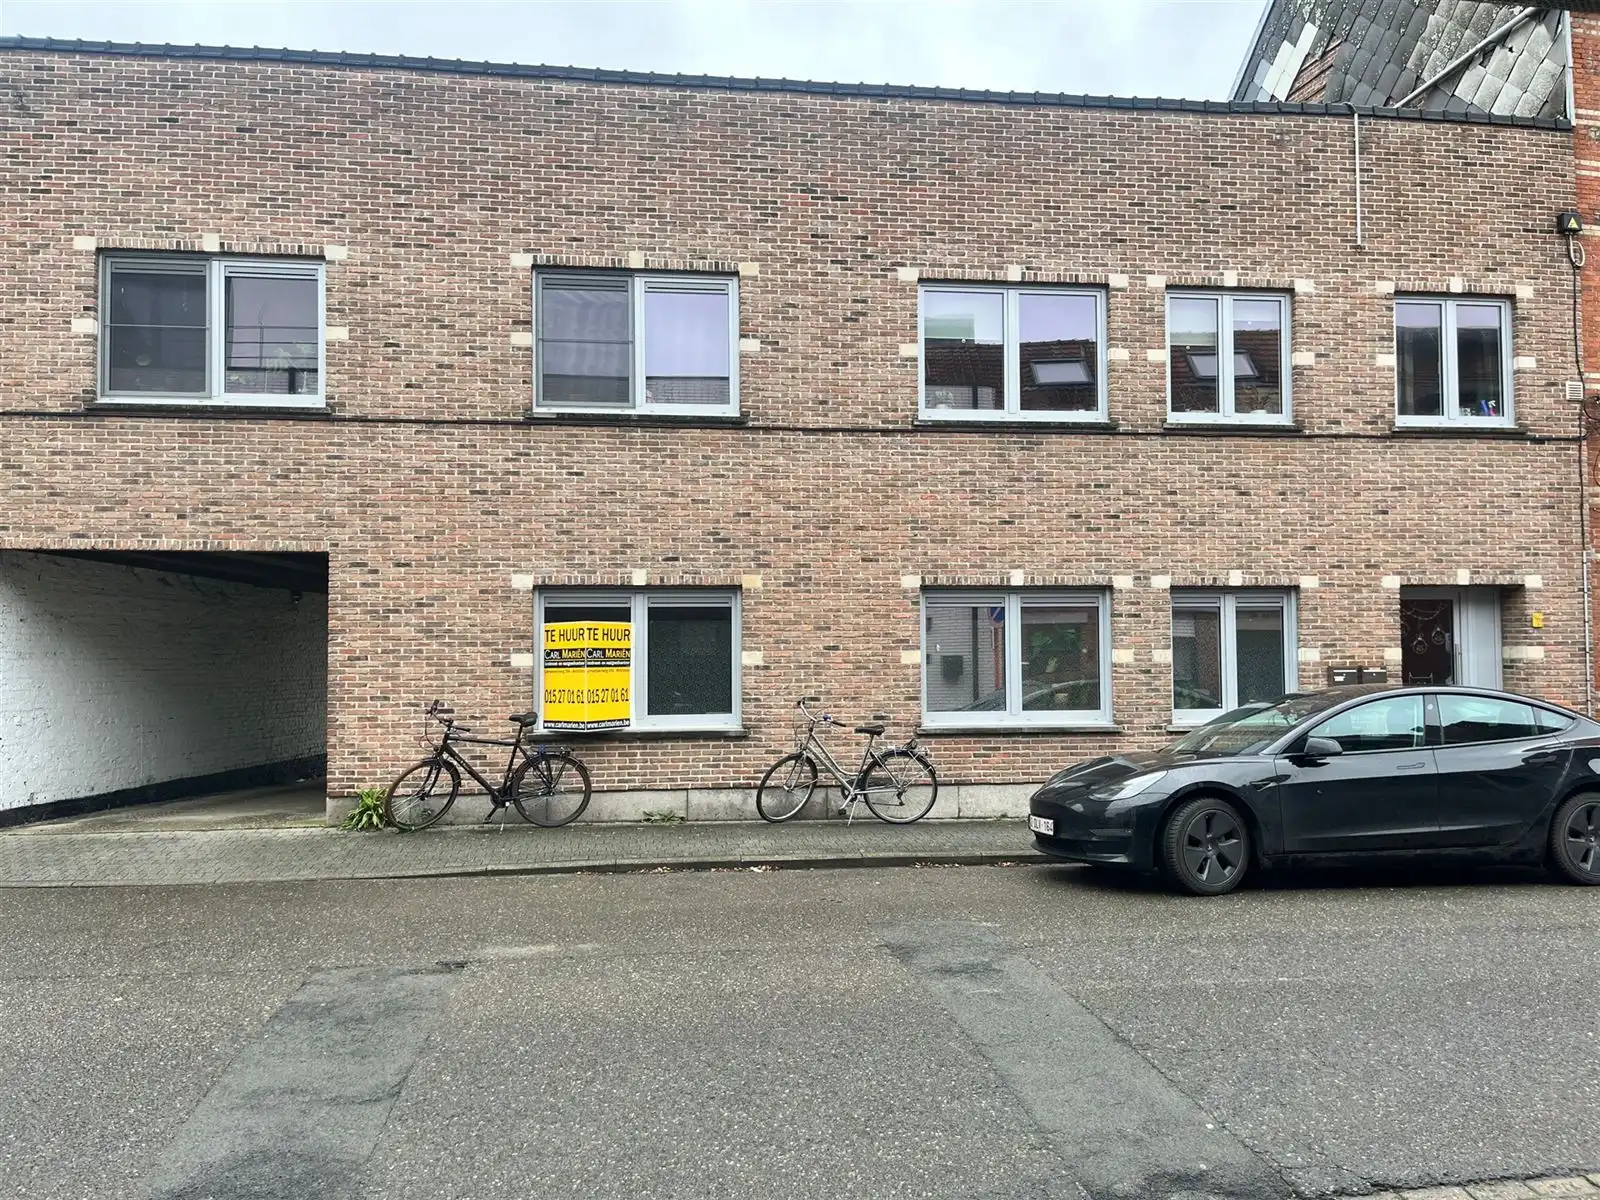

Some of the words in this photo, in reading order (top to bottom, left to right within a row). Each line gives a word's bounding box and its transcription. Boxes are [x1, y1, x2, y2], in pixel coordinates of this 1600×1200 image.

[545, 629, 556, 642] TE
[559, 628, 585, 641] HUUR
[587, 628, 599, 641] TE
[602, 628, 630, 641] HUUR
[544, 649, 561, 659] CARL
[587, 648, 604, 658] CARL
[544, 689, 557, 703] 015
[558, 689, 566, 703] 27
[567, 690, 575, 703] 01
[576, 690, 585, 703] 61
[587, 689, 600, 703] 015
[601, 689, 609, 703] 27
[611, 688, 619, 702] 01
[621, 688, 629, 701] 61
[544, 721, 585, 729] www.carlmarien.be
[587, 720, 630, 728] www.carlmarien.be
